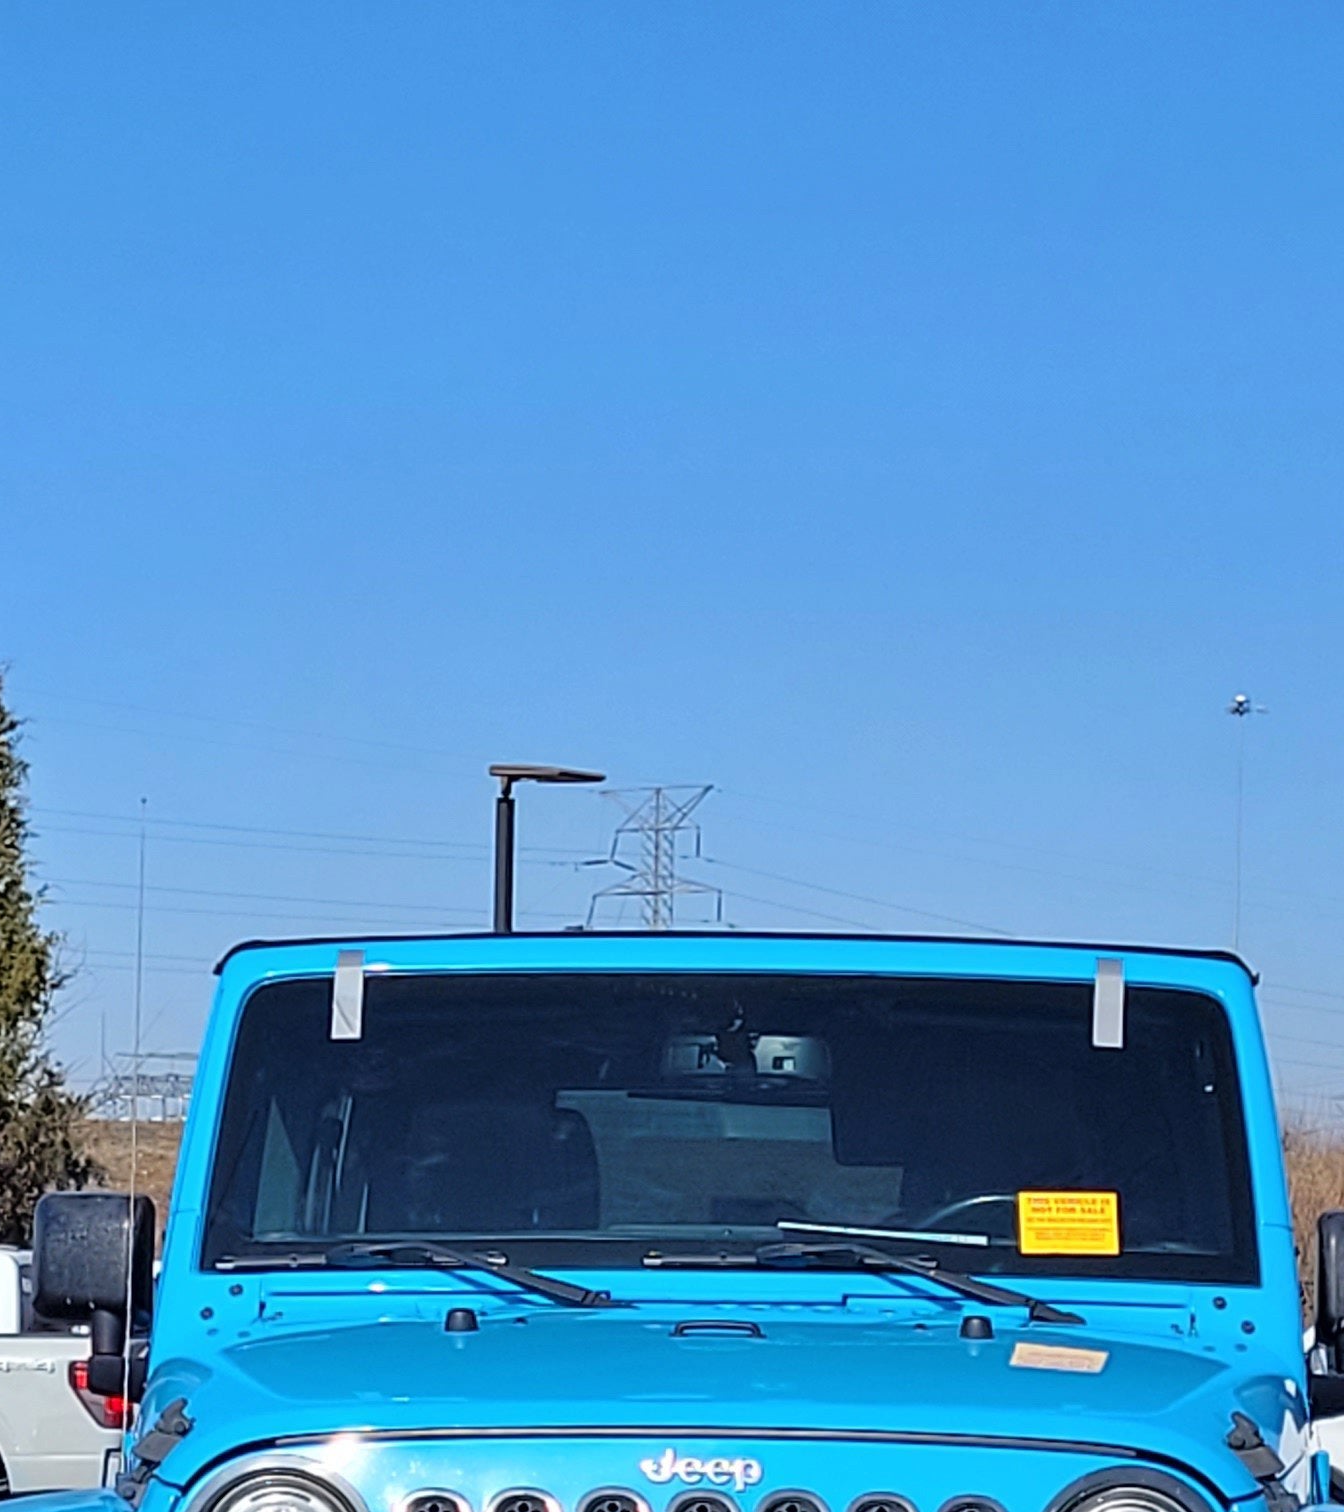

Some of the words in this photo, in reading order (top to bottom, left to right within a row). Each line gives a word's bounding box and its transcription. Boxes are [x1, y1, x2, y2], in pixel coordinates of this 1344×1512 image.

[1031, 1206, 1053, 1214] NOT
[1056, 1206, 1077, 1214] FOR
[1080, 1207, 1105, 1215] SALE
[640, 1448, 763, 1492] Jeep
